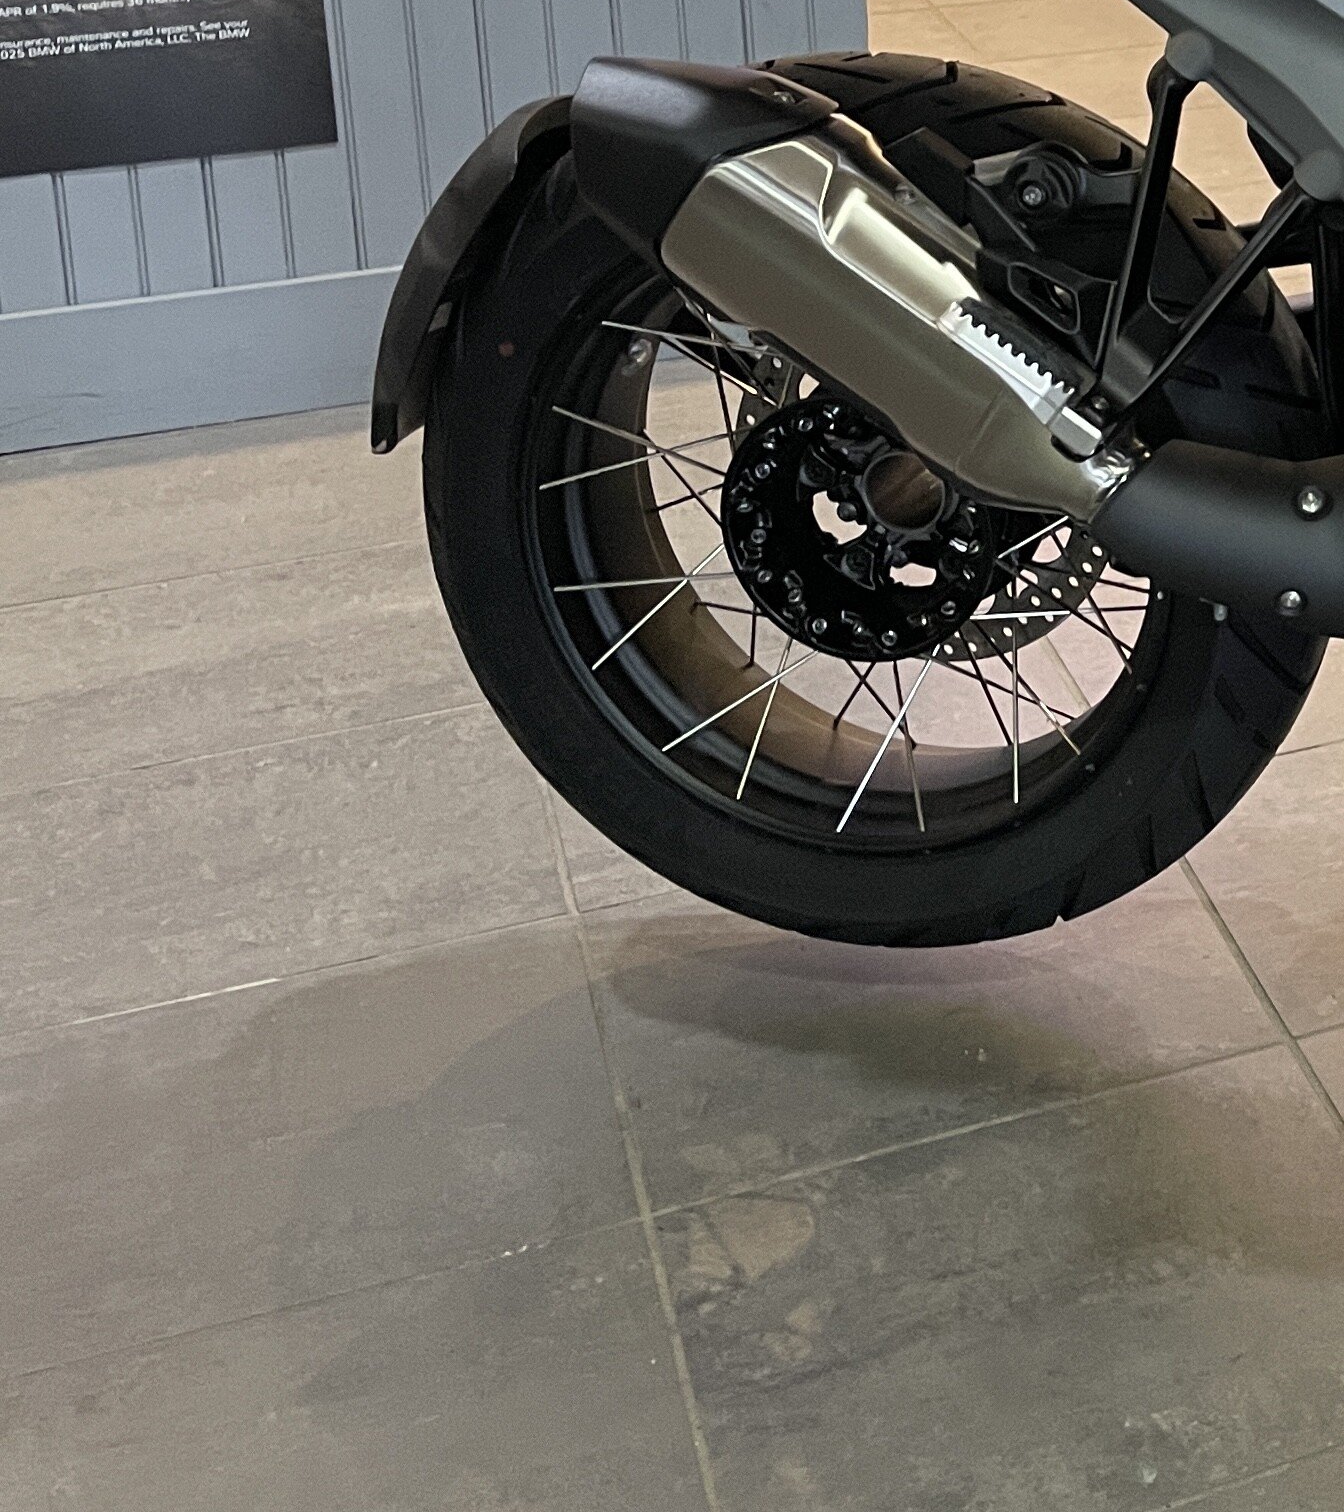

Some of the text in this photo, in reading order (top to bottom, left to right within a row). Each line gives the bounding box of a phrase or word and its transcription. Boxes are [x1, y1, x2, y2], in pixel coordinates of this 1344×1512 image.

[25, 4, 37, 16] of
[77, 0, 124, 11] requires
[28, 44, 61, 58] BMW
[63, 44, 76, 54] of
[78, 41, 113, 52] North
[114, 38, 164, 49] America,
[195, 31, 217, 42] The
[219, 28, 250, 40] BMW
[57, 30, 129, 44] maintenance
[132, 26, 154, 38] and
[200, 20, 221, 31] See
[223, 19, 248, 31] your
